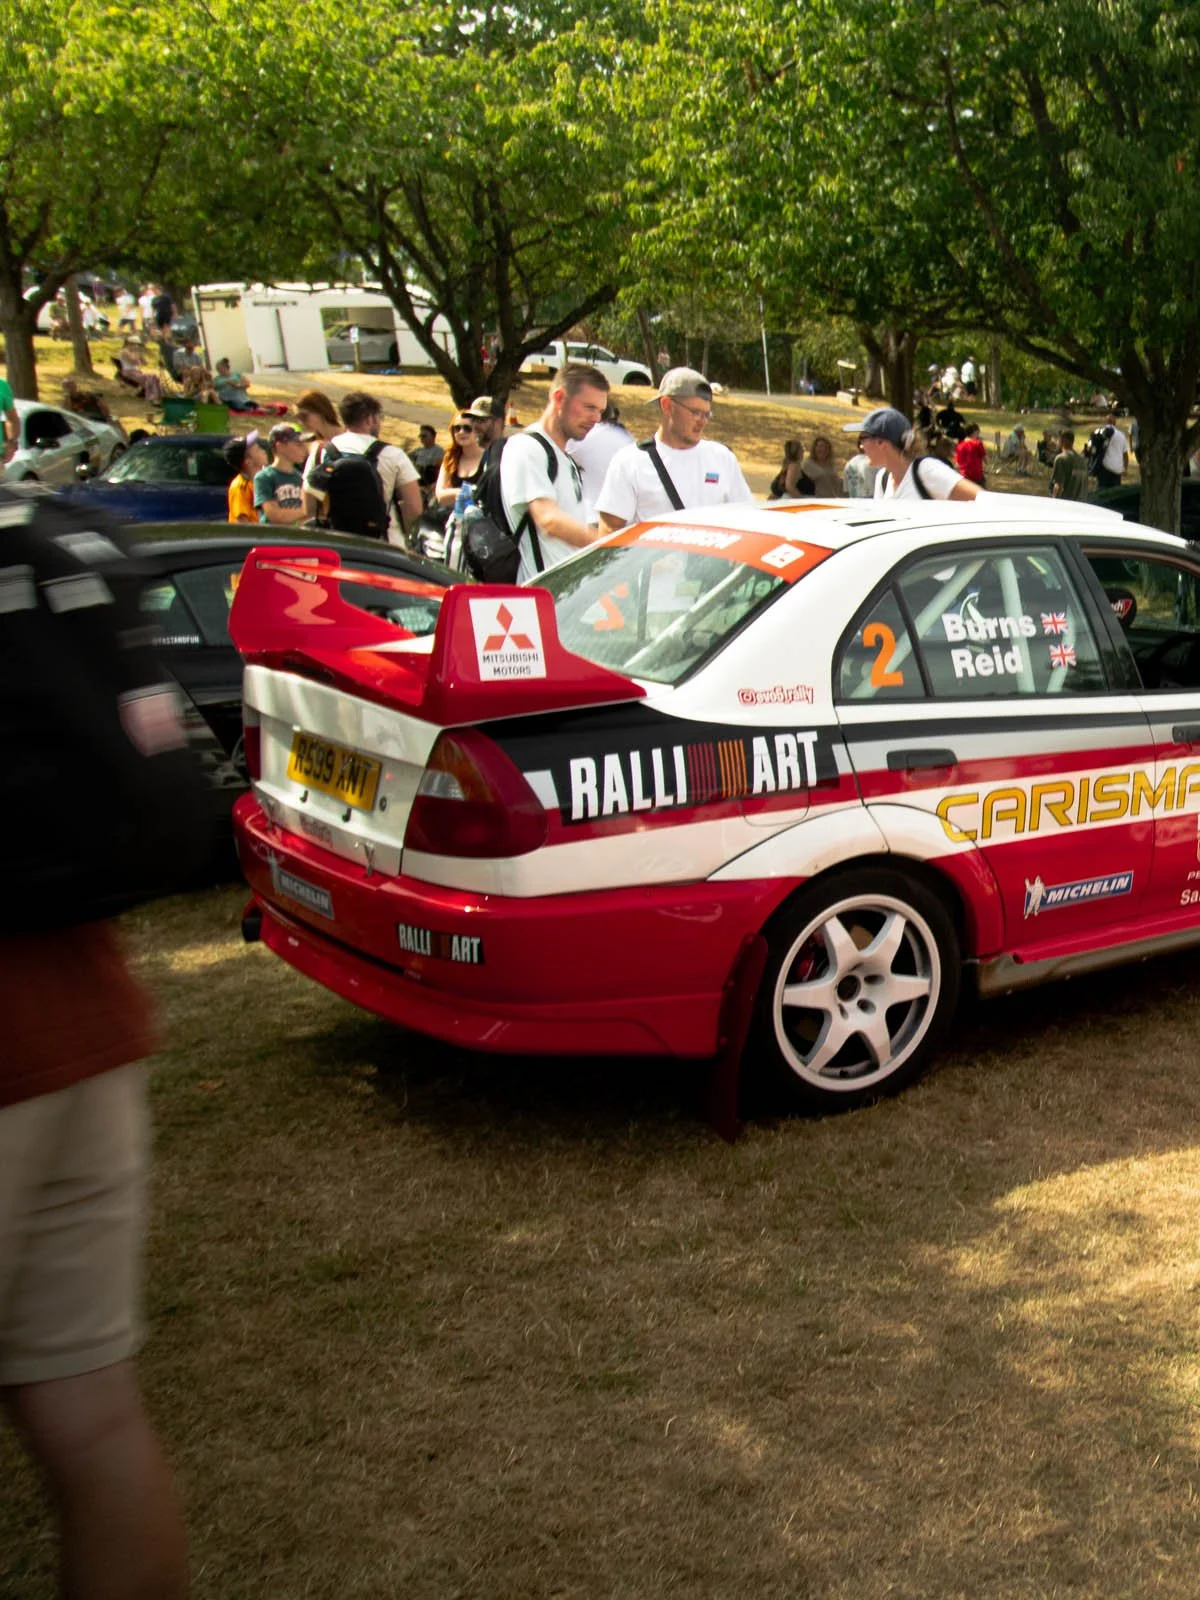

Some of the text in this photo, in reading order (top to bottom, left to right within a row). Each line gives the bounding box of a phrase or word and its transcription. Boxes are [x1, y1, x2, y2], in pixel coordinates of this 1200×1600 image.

[941, 612, 1037, 643] Burns
[482, 653, 539, 664] MITSUBISHI
[862, 621, 904, 689] 2
[950, 645, 1024, 679] Reid
[493, 665, 532, 677] MOTORS
[1047, 875, 1130, 905] MICHELIN
